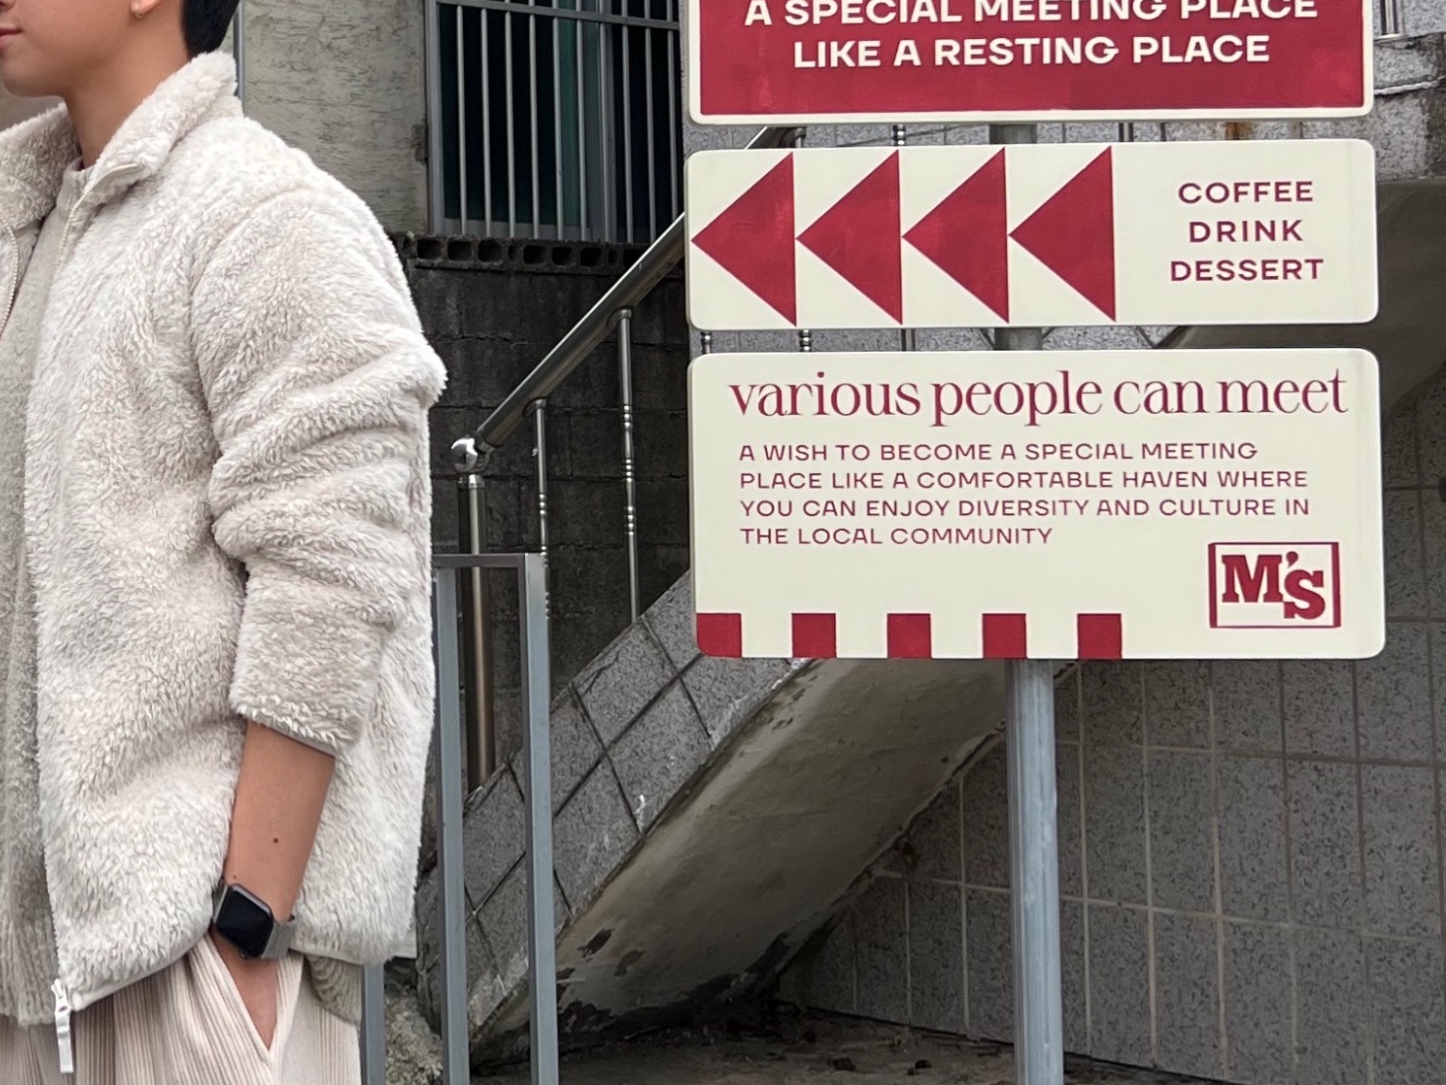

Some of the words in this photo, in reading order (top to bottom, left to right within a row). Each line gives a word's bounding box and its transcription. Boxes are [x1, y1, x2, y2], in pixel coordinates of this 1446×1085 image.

[744, 0, 772, 26] A
[784, 0, 962, 26] SPECIAL
[974, 0, 1167, 22] MEETING
[1181, 0, 1318, 19] PLACE
[794, 40, 881, 68] LIKE
[893, 39, 921, 67] A
[934, 37, 1119, 66] RESTING
[1133, 35, 1270, 63] PLACE
[1178, 180, 1314, 205] COFFEE
[1189, 219, 1303, 243] DRINK
[1170, 258, 1324, 282] DESSERT
[729, 371, 921, 417] various
[931, 369, 1103, 428] people
[1113, 380, 1208, 415] can
[1217, 369, 1349, 414] meet
[739, 444, 755, 462] A
[763, 444, 827, 462] WISH
[834, 444, 871, 462] TO
[880, 443, 992, 461] BECOME
[1000, 443, 1017, 460] A
[1025, 442, 1134, 461] SPECIAL
[1141, 442, 1258, 460] MEETING
[740, 472, 822, 490] PLACE
[832, 472, 884, 489] LIKE
[892, 472, 909, 489] A
[916, 471, 1113, 489] COMFORTABLE
[1122, 471, 1207, 488] HAVEN
[1217, 470, 1308, 488] WHERE
[740, 499, 793, 517] YOU
[802, 499, 856, 517] CAN
[866, 499, 950, 517] ENJOY
[958, 499, 1089, 517] DIVERSITY
[1096, 499, 1150, 516] AND
[1158, 498, 1276, 517] CULTURE
[1285, 498, 1309, 516] IN
[739, 528, 789, 545] THE
[798, 527, 883, 545] LOCAL
[890, 527, 1053, 545] COMMUNITY
